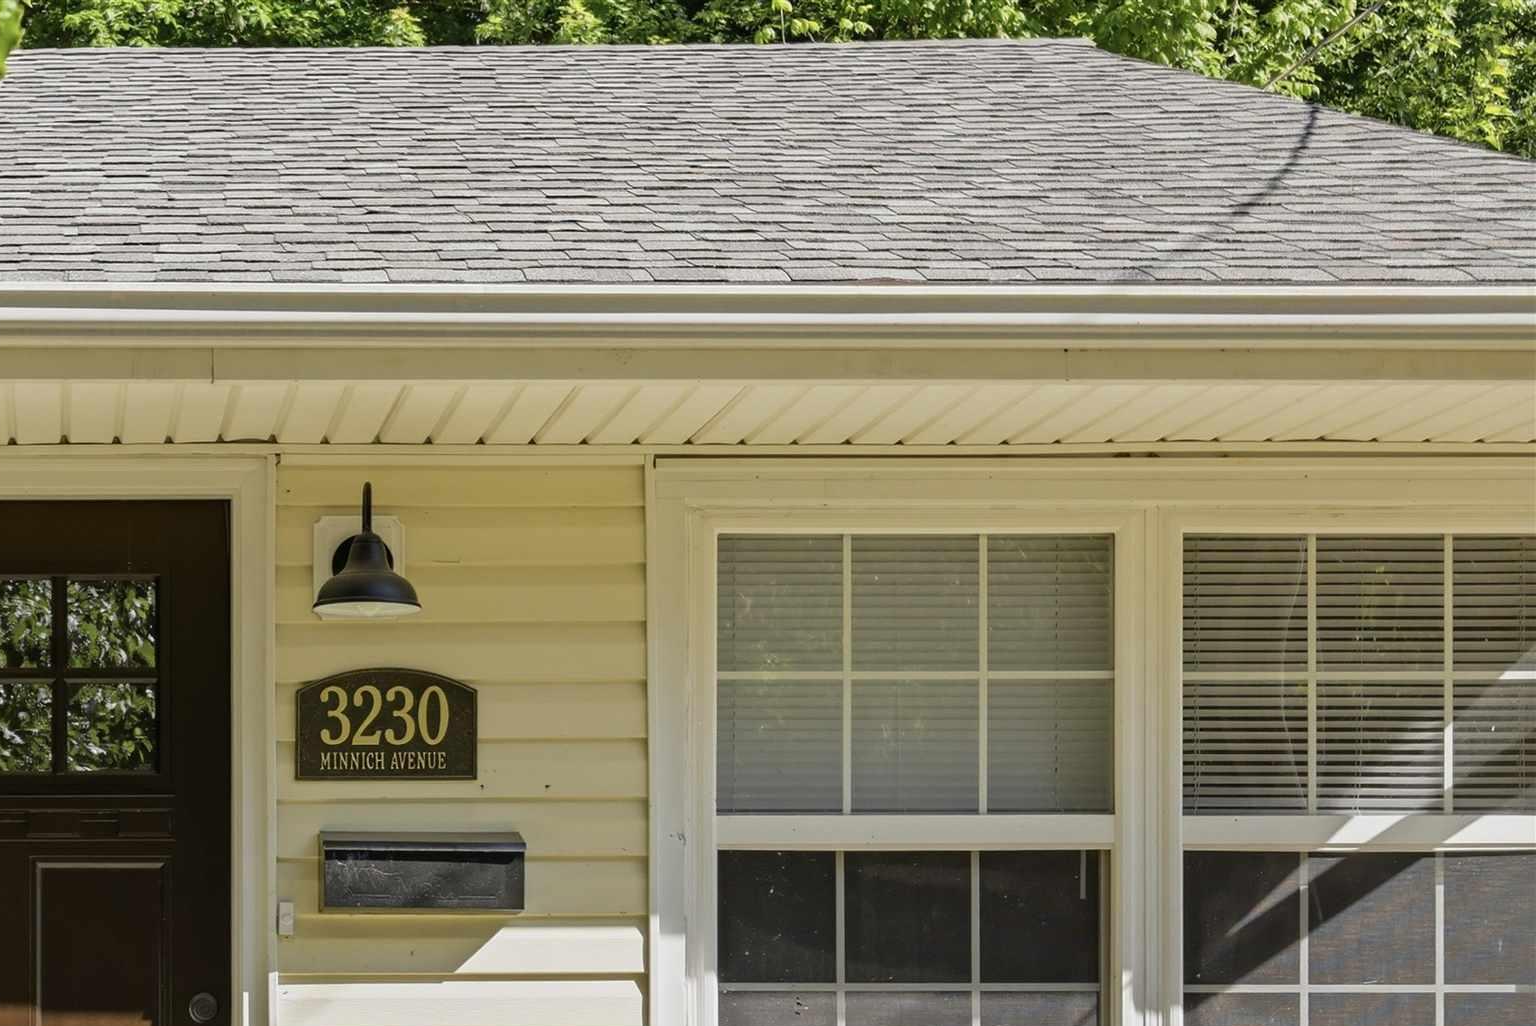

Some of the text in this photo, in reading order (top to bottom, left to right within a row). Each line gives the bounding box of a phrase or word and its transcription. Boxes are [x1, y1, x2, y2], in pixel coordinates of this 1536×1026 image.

[319, 685, 449, 745] 3230
[320, 752, 447, 770] MINNICH AVENUE
